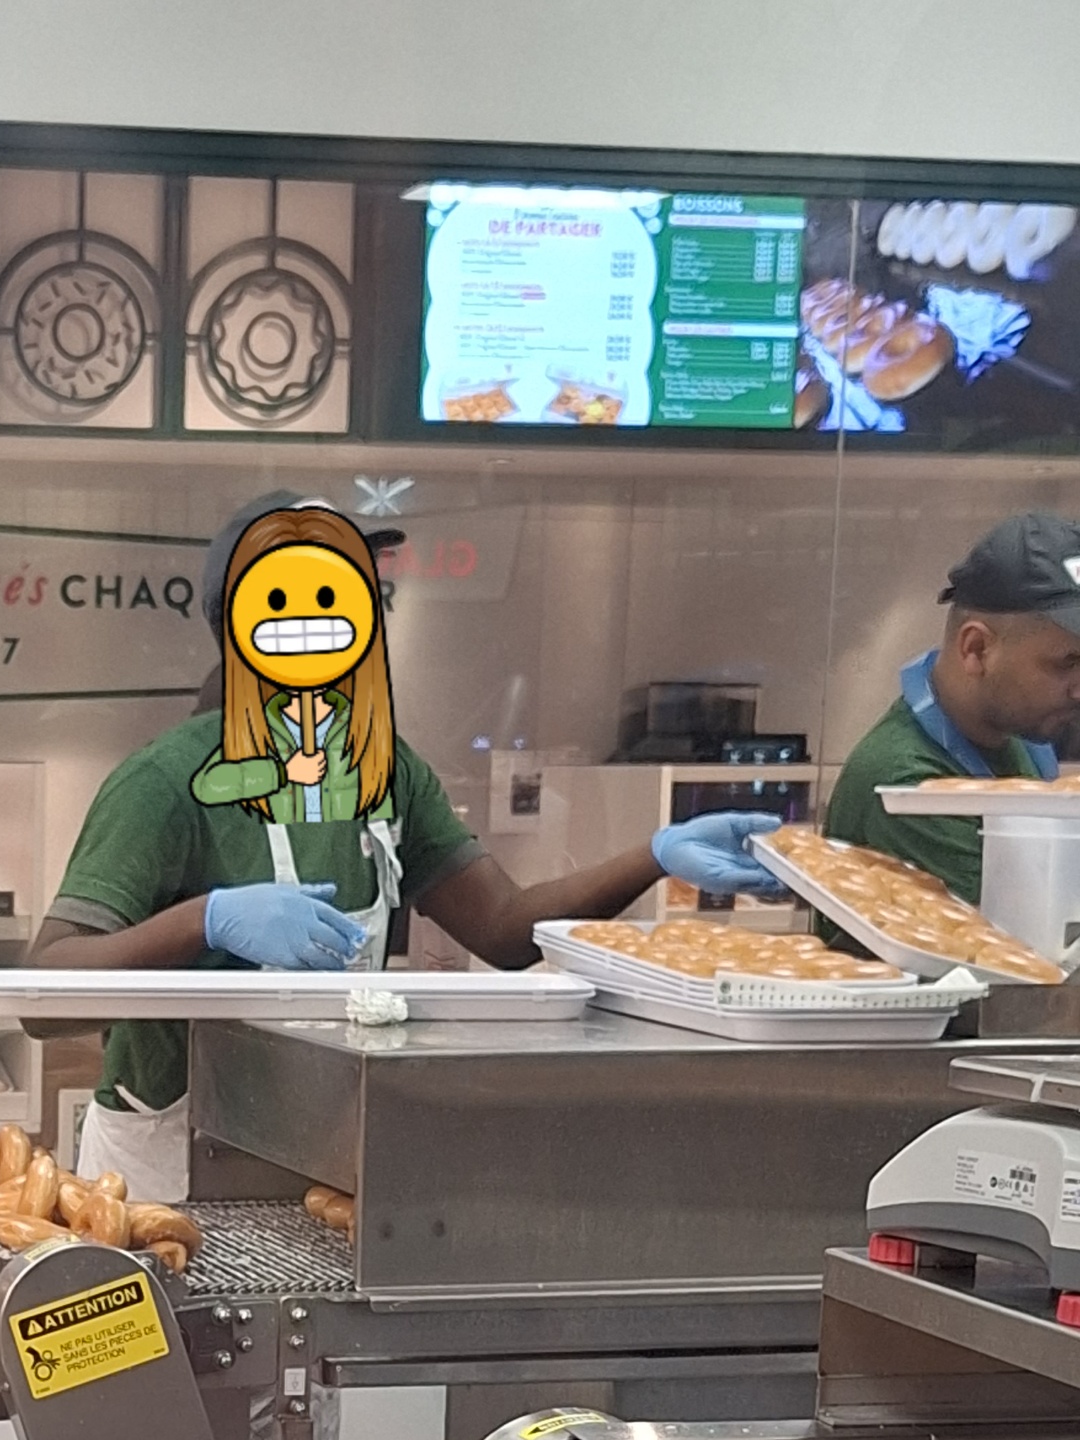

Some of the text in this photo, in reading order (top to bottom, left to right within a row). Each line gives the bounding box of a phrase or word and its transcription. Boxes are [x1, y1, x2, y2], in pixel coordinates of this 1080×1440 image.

[60, 574, 194, 619] CHAQ
[43, 1285, 138, 1330] ATTENTION
[59, 1320, 136, 1352] NE PAS UTILISER
[62, 1349, 89, 1363] SANS
[89, 1342, 108, 1354] LES
[144, 1323, 158, 1336] DE
[66, 1347, 126, 1373] PROTECTION
